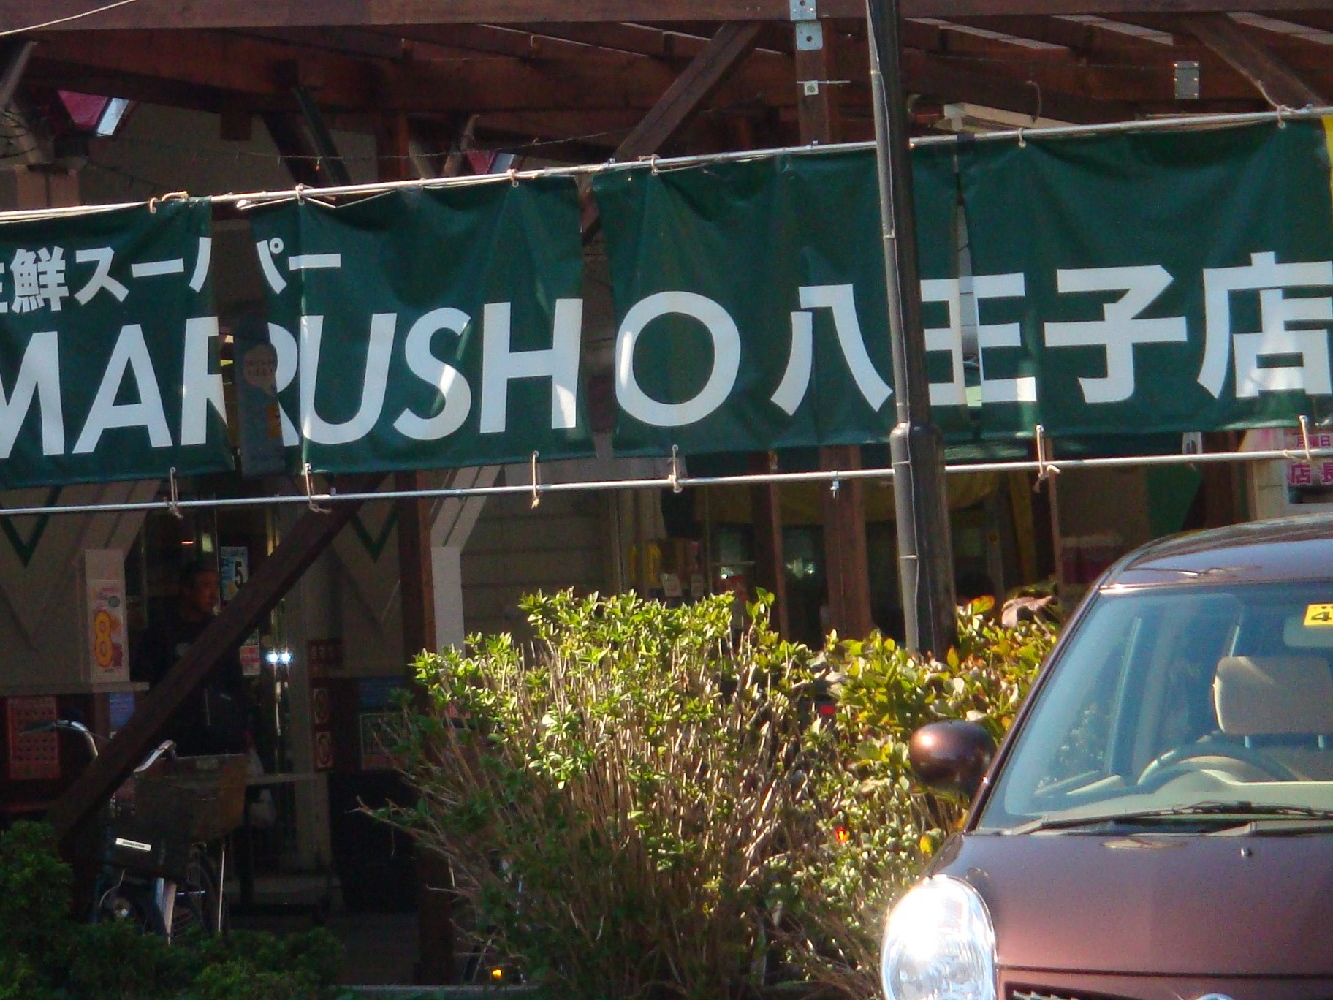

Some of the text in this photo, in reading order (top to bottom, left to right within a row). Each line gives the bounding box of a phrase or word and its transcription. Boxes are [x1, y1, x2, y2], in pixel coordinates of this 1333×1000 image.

[770, 250, 1333, 416] 八王子店
[94, 610, 114, 668] 8
